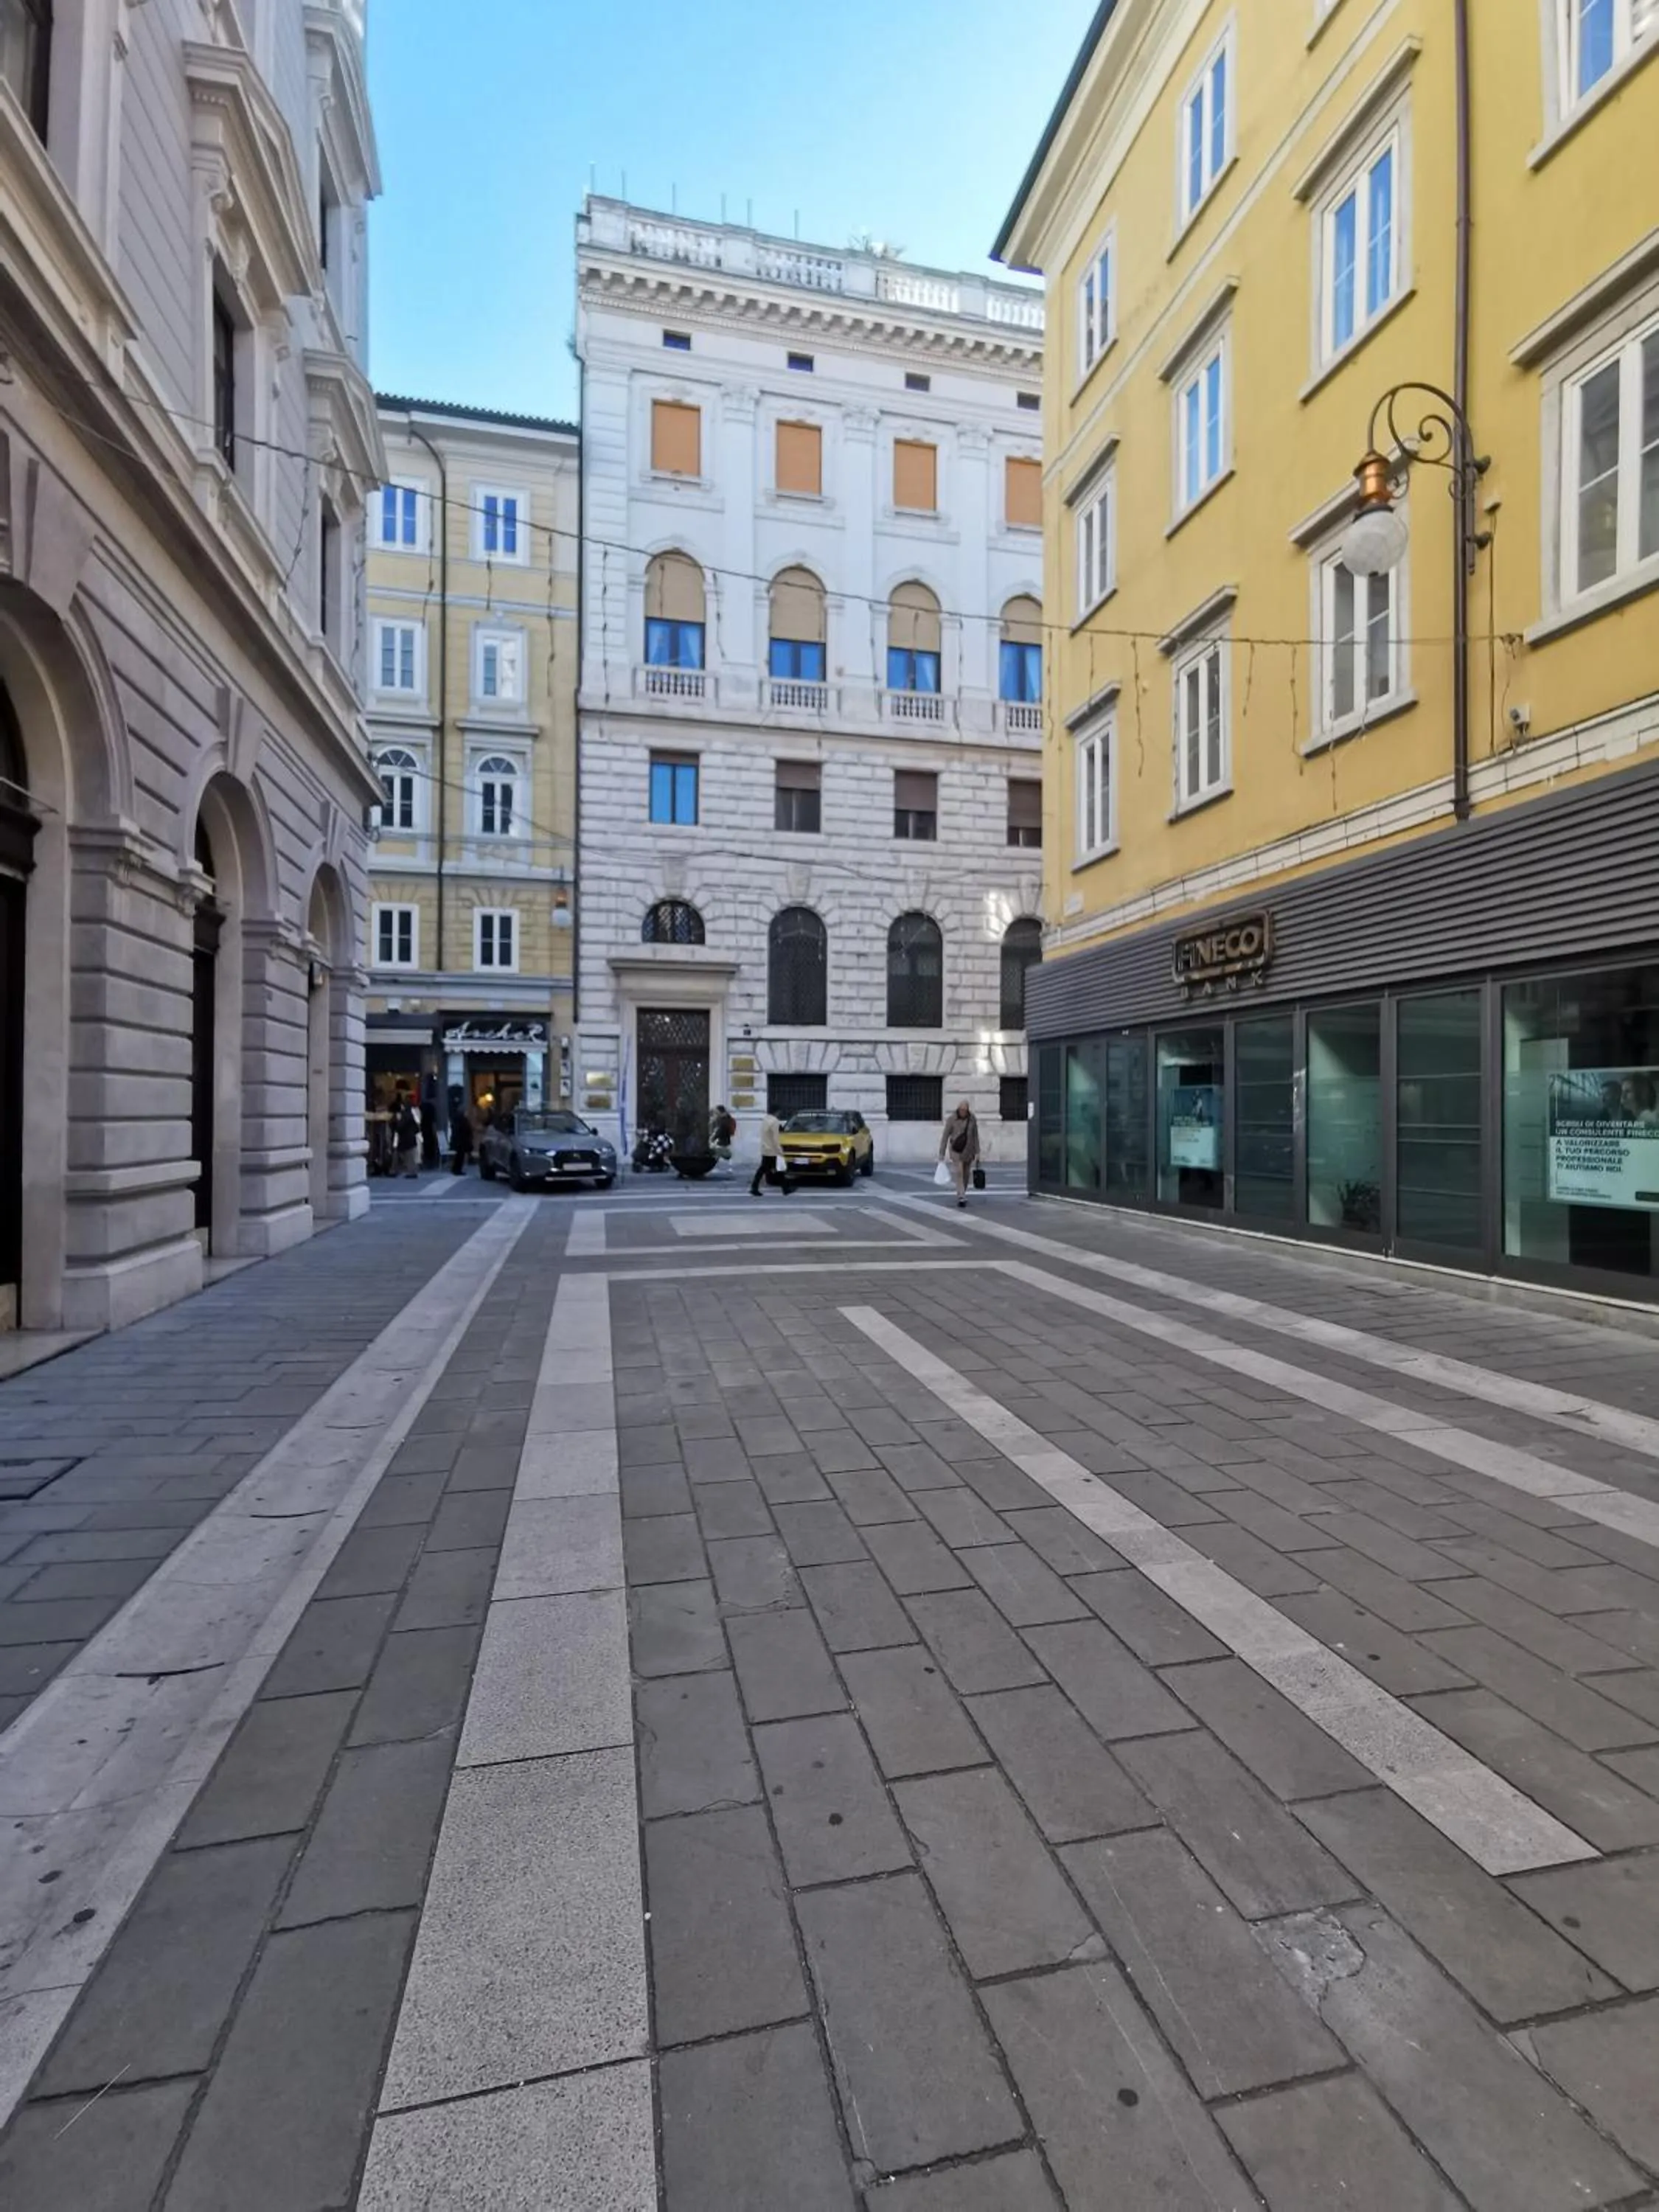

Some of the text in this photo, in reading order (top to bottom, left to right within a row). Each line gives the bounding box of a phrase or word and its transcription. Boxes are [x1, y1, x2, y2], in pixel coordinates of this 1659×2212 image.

[1178, 926, 1260, 971] FINECO
[1180, 968, 1263, 999] BANK
[1596, 1120, 1645, 1128] DIVENTARE
[1569, 1128, 1624, 1136] CONSULENTE
[1564, 1138, 1620, 1147] VALORIZZARE
[1583, 1148, 1630, 1157] PERCORSO
[1556, 1155, 1622, 1164] PROFESSIONALE
